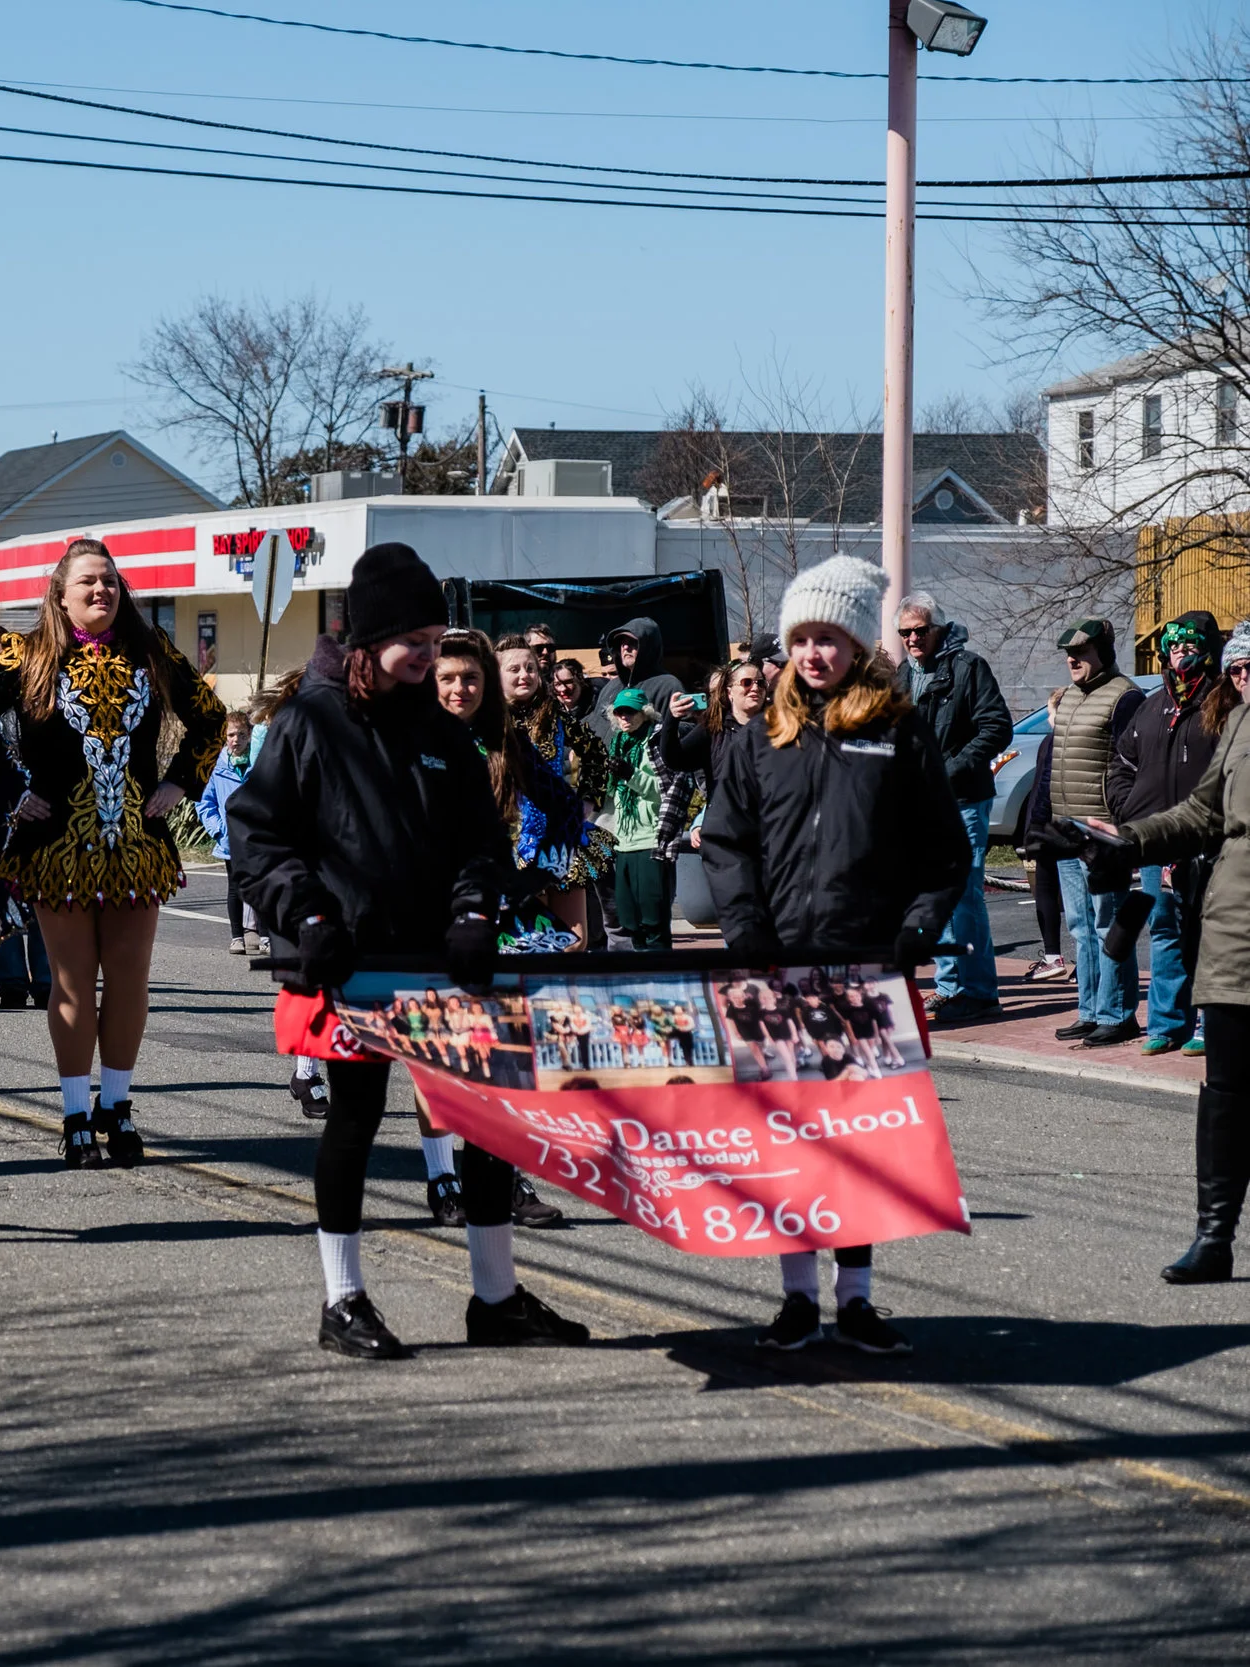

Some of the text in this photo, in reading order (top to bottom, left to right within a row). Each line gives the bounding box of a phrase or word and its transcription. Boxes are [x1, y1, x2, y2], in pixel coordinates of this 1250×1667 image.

[213, 534, 232, 556] BAY
[286, 527, 310, 551] HOP
[499, 1096, 925, 1151] Irish Dance School
[694, 1148, 759, 1168] today!
[527, 1133, 841, 1243] 732 784 8266
